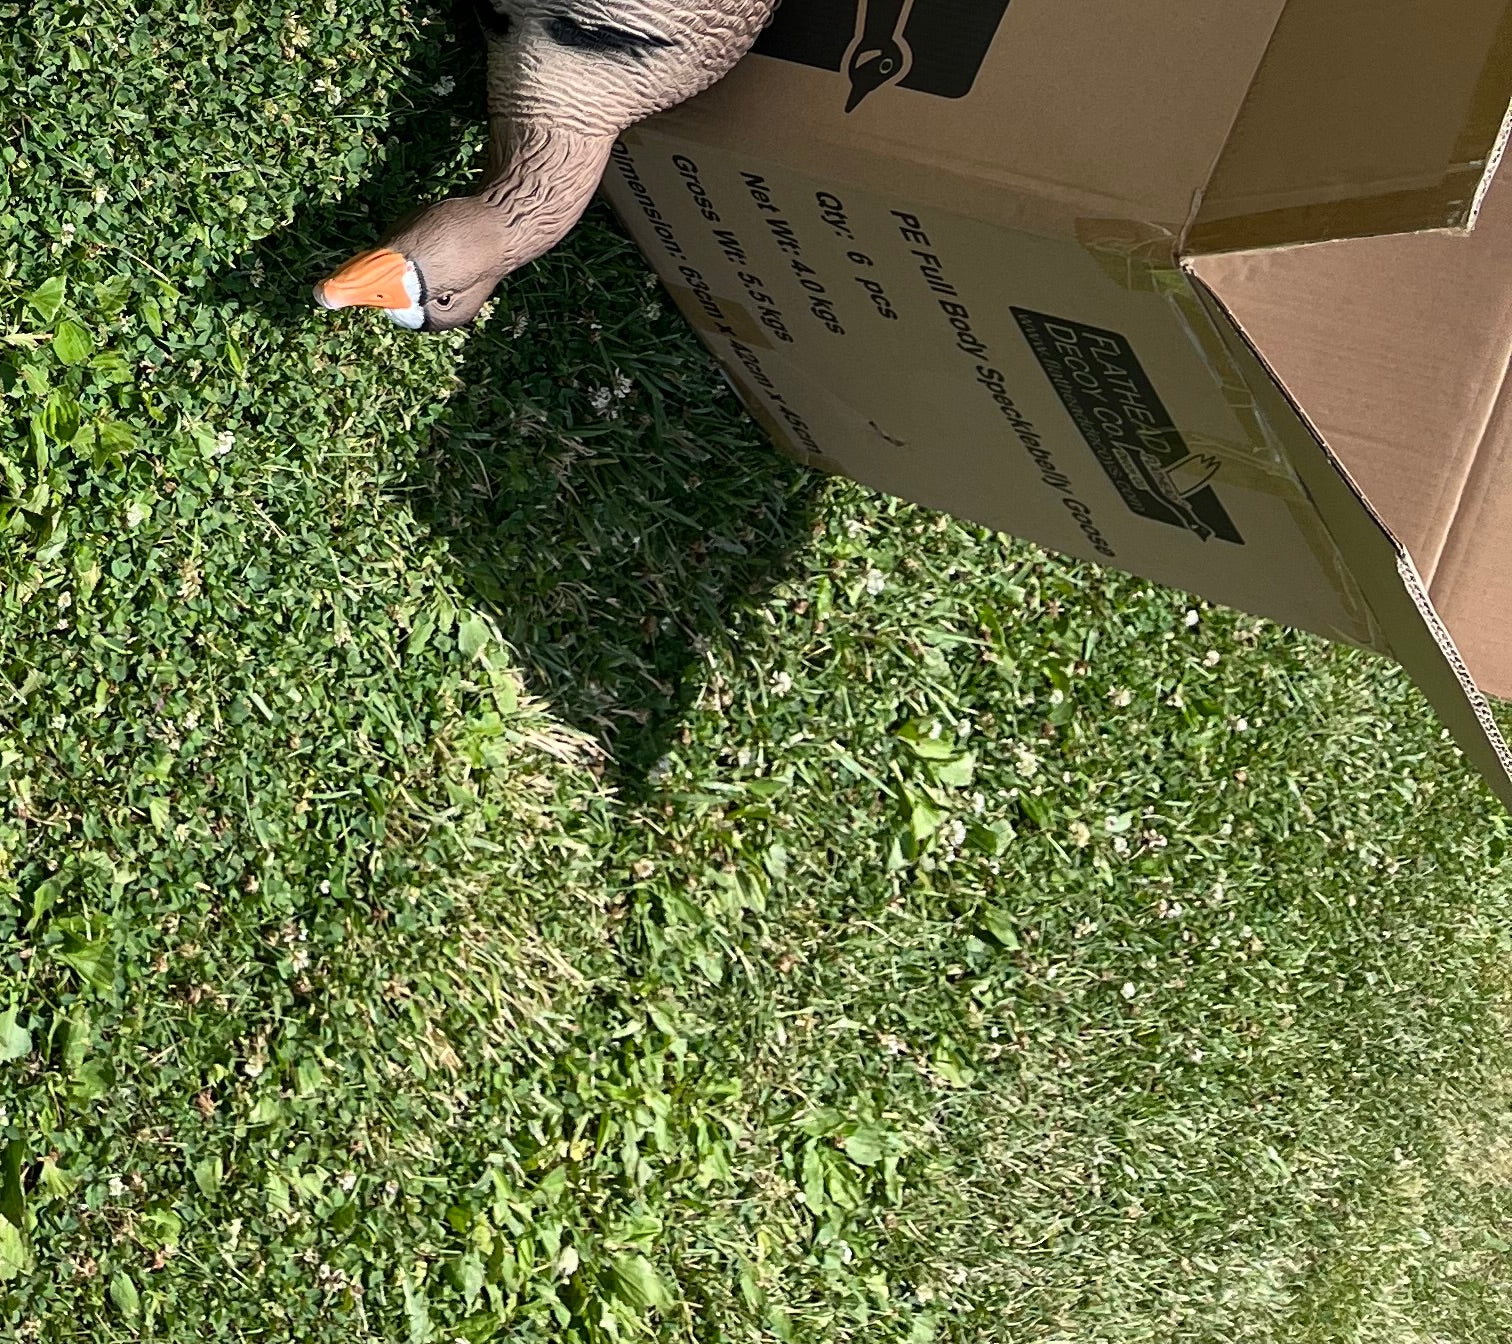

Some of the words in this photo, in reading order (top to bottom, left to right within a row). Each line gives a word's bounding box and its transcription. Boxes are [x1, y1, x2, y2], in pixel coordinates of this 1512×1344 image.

[672, 154, 720, 223] Gross
[712, 229, 747, 265] Wt:
[740, 171, 780, 212] Net
[765, 219, 801, 256] Wt:
[791, 259, 825, 293] 4.0
[808, 295, 845, 335] kgs
[815, 191, 854, 240] Qty:
[847, 251, 873, 266] 6
[611, 139, 687, 261] Dimension:
[678, 265, 724, 319] 63cm
[714, 321, 737, 337] x
[730, 338, 774, 389] 42cm
[764, 389, 787, 405] x
[854, 276, 898, 320] pcs
[890, 210, 931, 247] PE
[911, 249, 957, 297] Full
[938, 299, 989, 362] Body
[976, 364, 1072, 494] Specklebelly
[1063, 497, 1116, 558] Goose
[1044, 322, 1108, 403] DECOY
[1082, 332, 1171, 454] FLATHEAD
